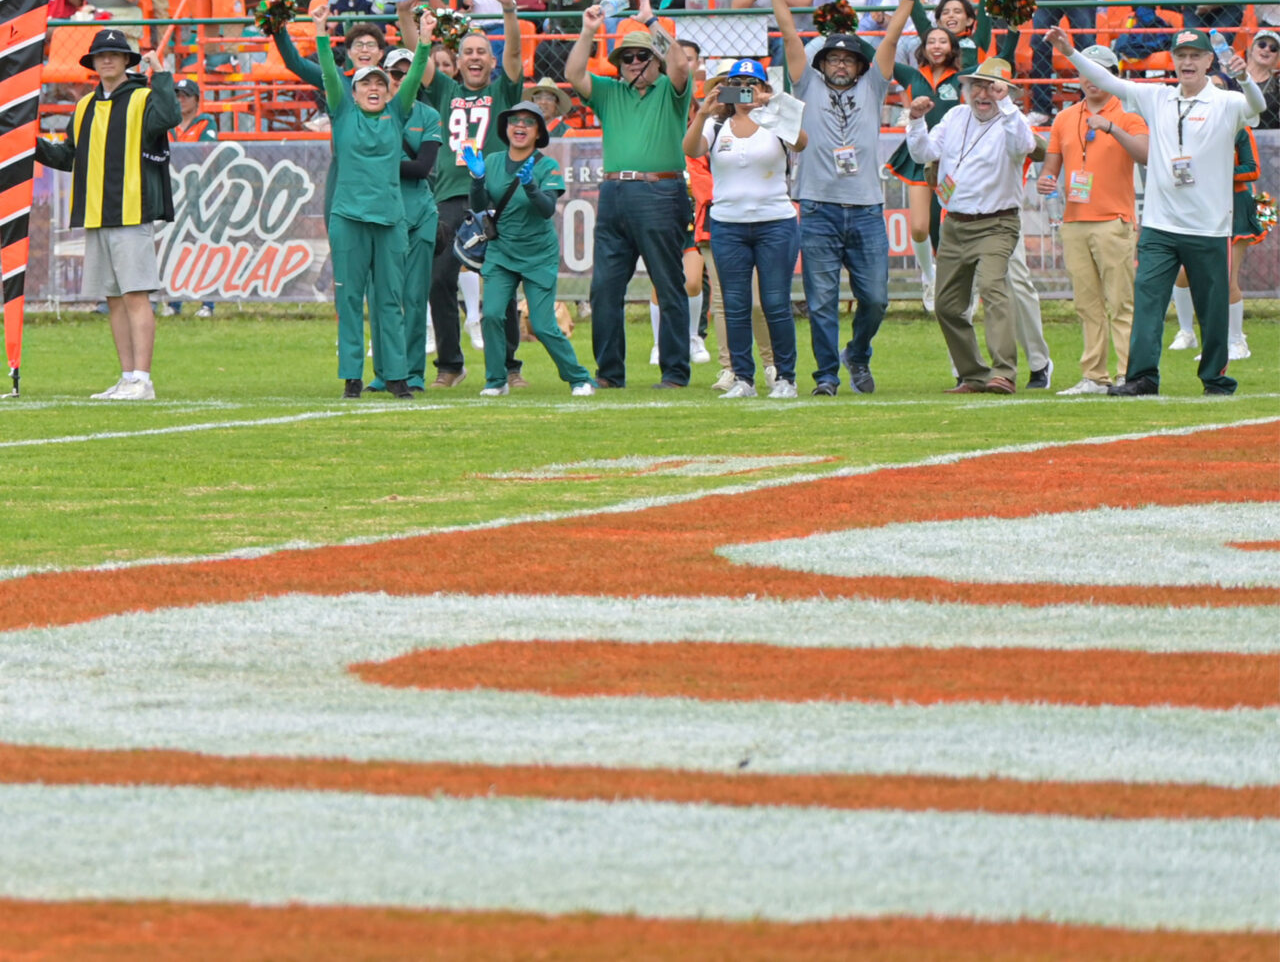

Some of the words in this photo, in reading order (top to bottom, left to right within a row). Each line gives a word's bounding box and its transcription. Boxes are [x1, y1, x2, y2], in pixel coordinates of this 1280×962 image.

[739, 61, 755, 73] a
[448, 107, 491, 152] 97
[888, 213, 908, 253] 0
[170, 244, 311, 294] UDLAP
